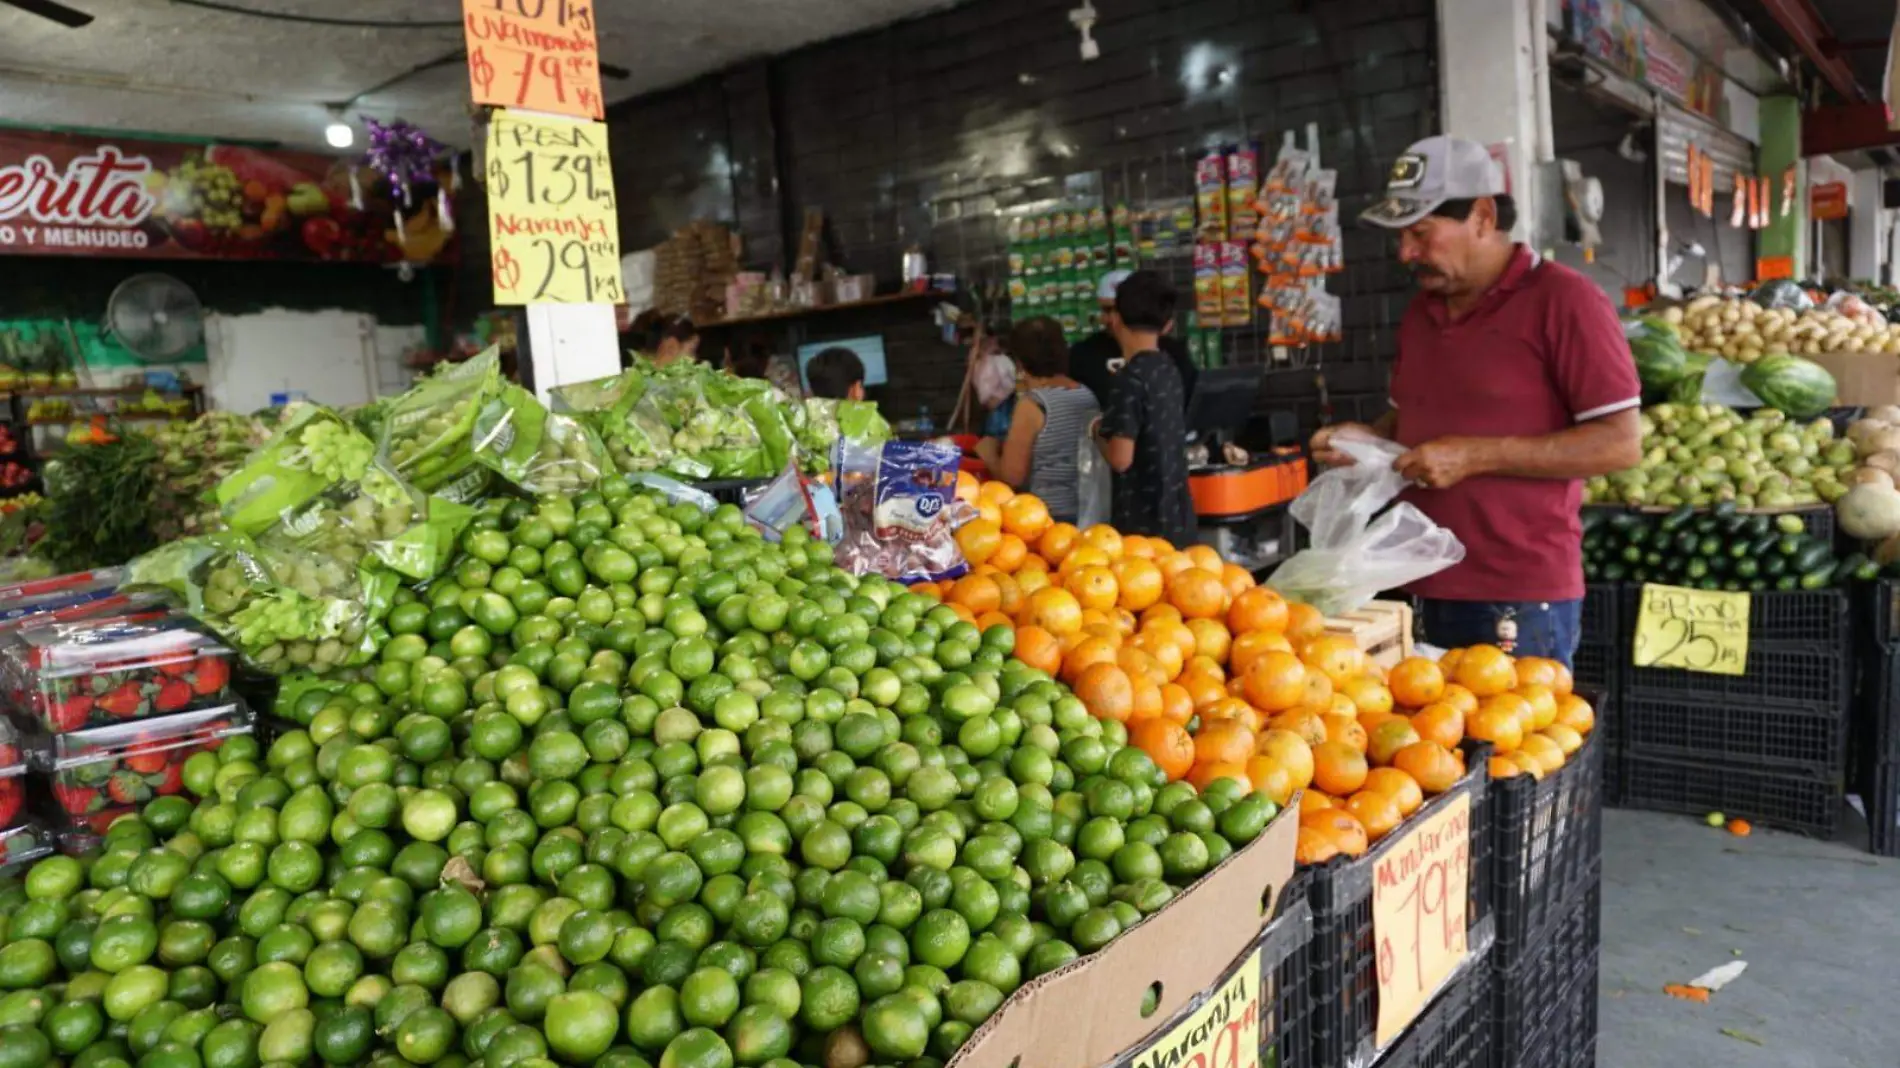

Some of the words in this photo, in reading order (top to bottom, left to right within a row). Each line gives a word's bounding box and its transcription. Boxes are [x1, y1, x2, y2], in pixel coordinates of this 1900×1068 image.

[22, 225, 37, 245] Y
[43, 226, 149, 248] MENUDEO
[494, 212, 609, 242] Naranja
